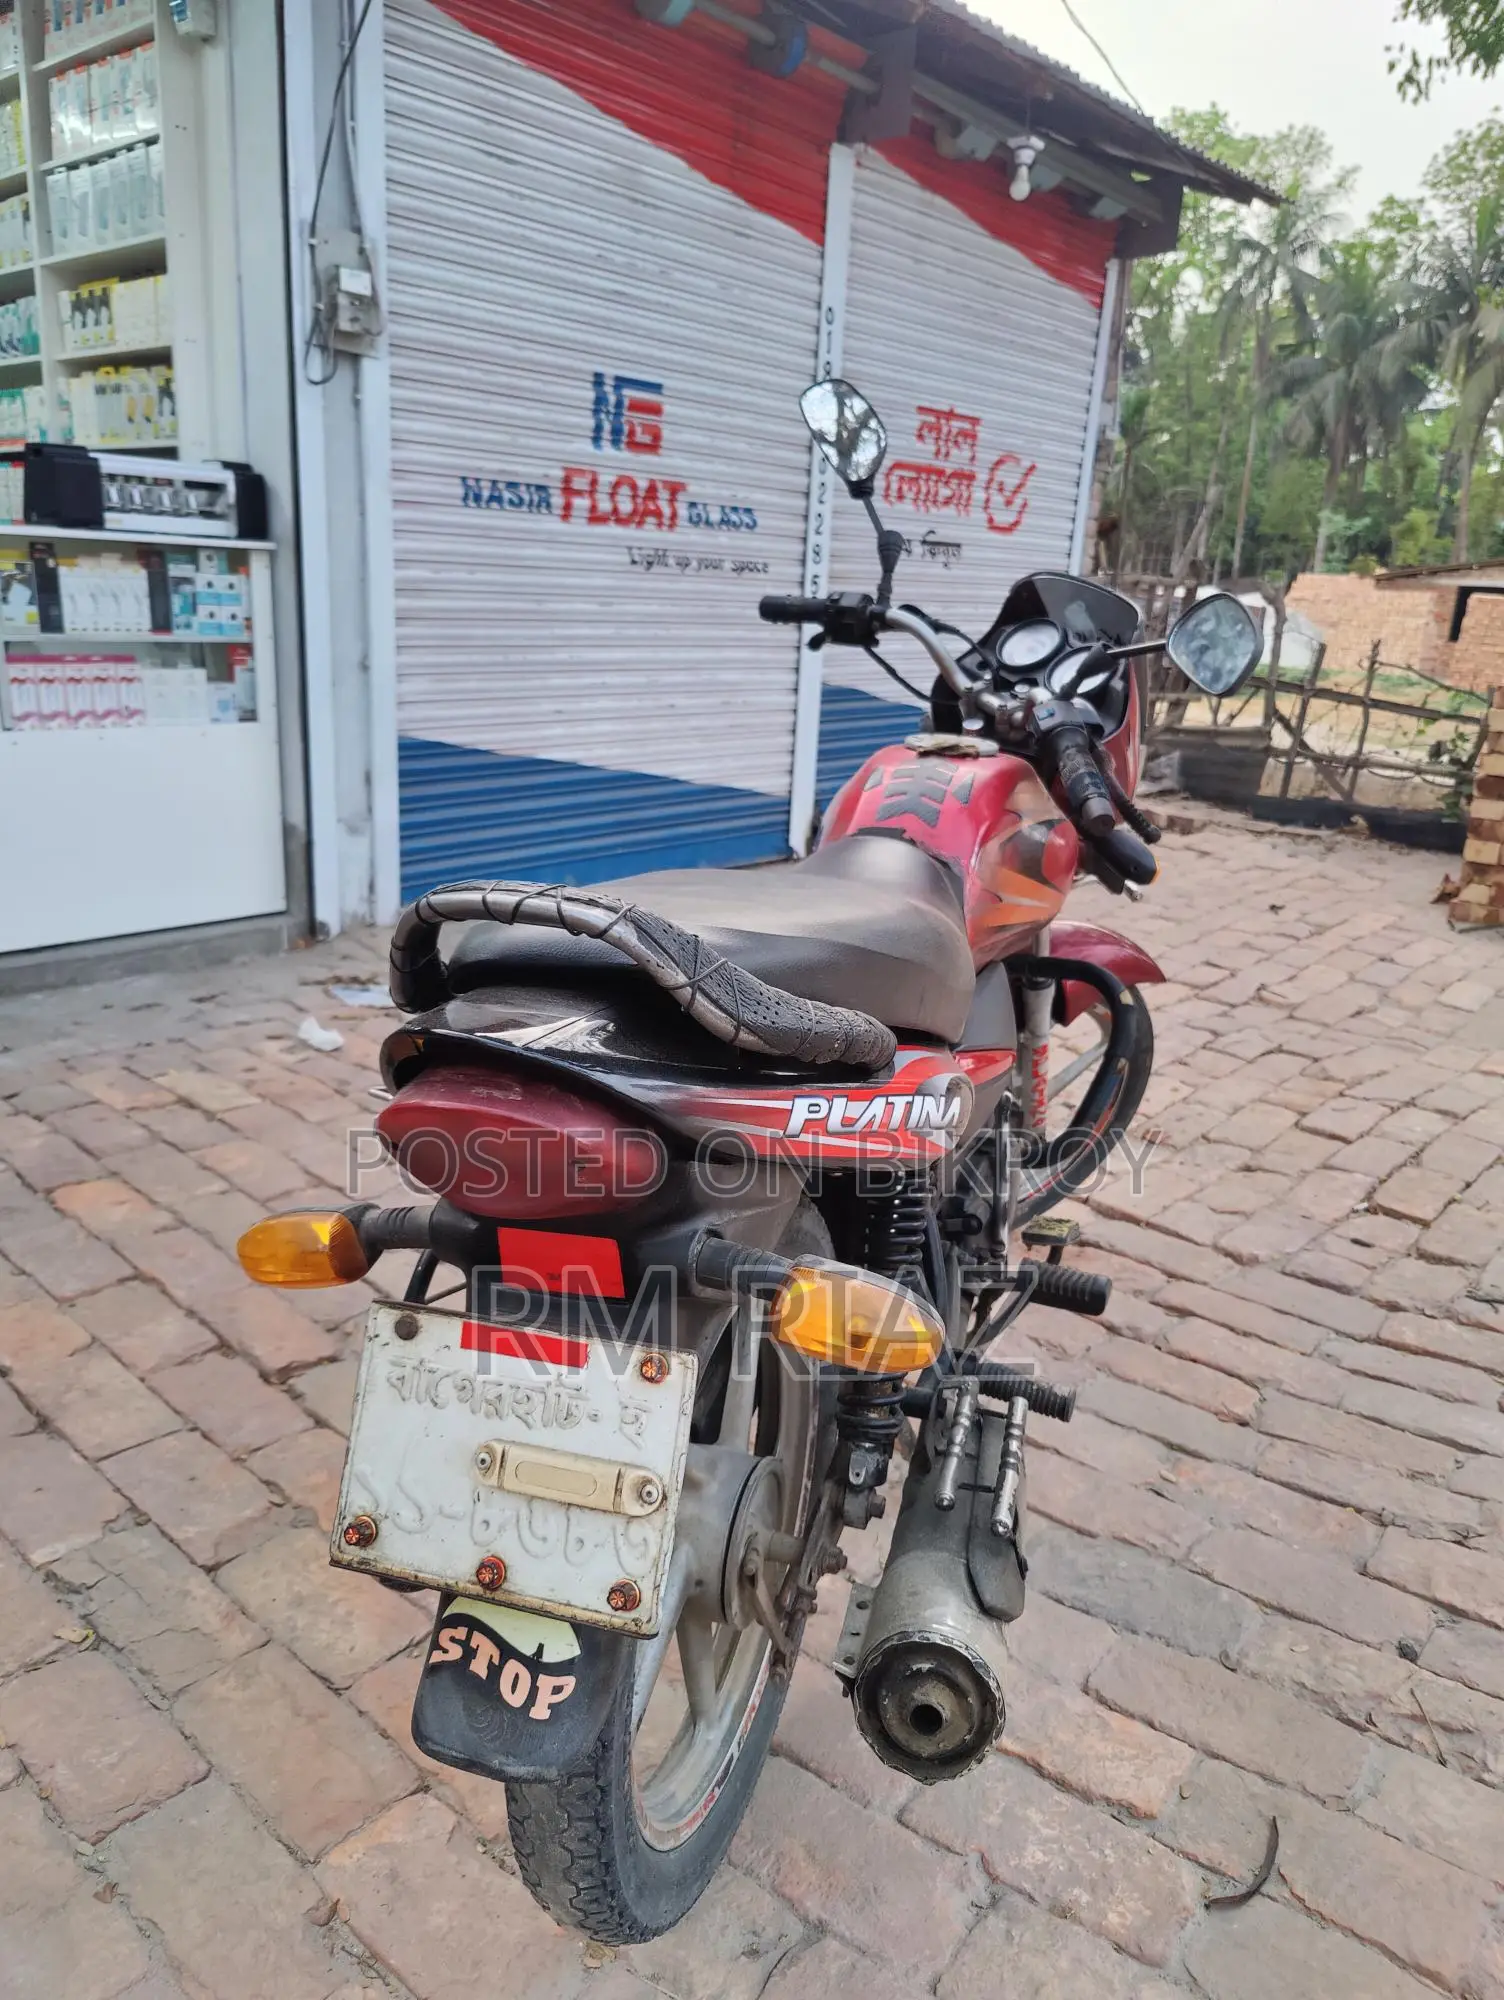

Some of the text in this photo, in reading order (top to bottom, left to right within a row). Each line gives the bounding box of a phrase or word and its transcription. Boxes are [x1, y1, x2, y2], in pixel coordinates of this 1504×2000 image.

[915, 405, 983, 463] লাল
[459, 466, 758, 532] NASIR FLOAT GLASS
[626, 546, 670, 571] Light
[730, 559, 769, 577] space
[783, 1094, 961, 1139] PLATINA
[429, 1626, 576, 1720] STOP
